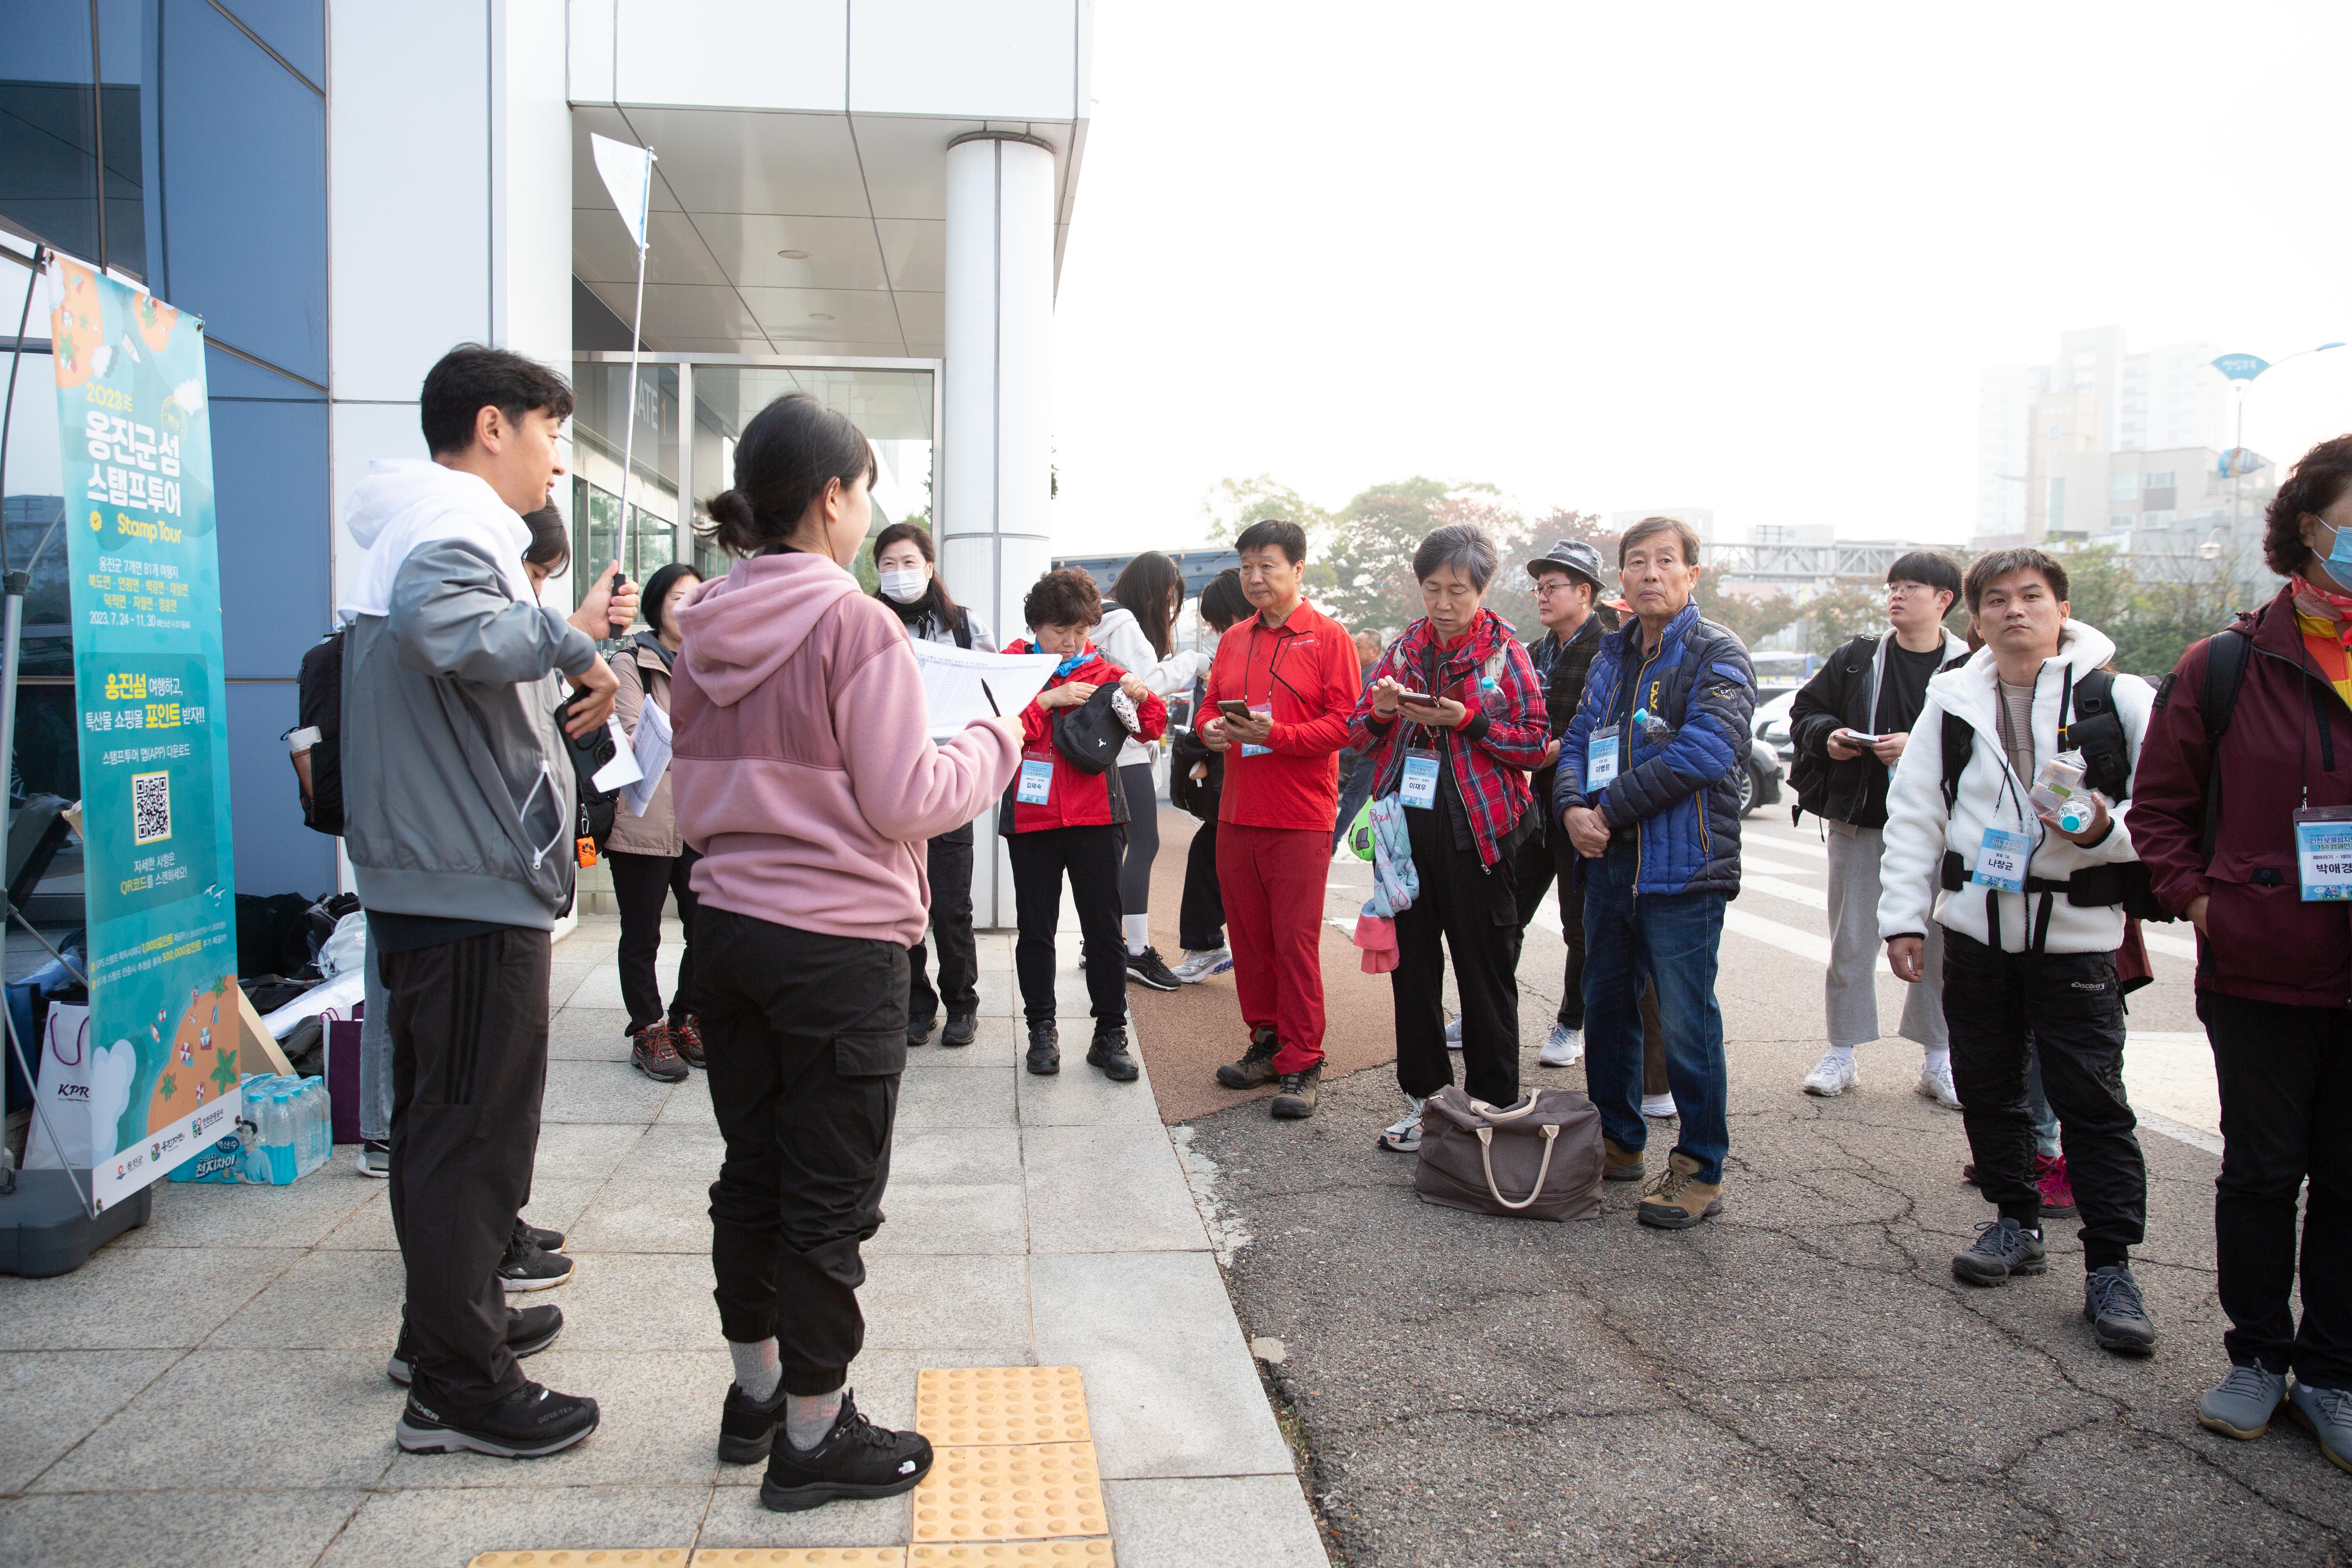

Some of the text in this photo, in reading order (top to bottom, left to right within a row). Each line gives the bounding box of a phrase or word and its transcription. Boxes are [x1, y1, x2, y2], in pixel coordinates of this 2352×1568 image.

[86, 382, 122, 411] 2023
[635, 378, 658, 430] ATE
[85, 410, 180, 477] 옹진군 섬
[87, 463, 181, 517] 스탬프투어
[118, 512, 182, 544] Stamp Tour
[99, 556, 178, 579] 옹진군 7개면 81개 여행지
[89, 574, 111, 590] 북도면
[104, 594, 127, 609] 덕적면
[105, 673, 183, 700] 옹진섬 여행하고,
[1650, 681, 1660, 710] DLX
[85, 703, 205, 731] 특산물 쇼핑몰 포인트 받자!!
[103, 743, 191, 765] 스탬프투어 앱(APP) 다운로드
[1595, 764, 1610, 773] 이병용
[1409, 782, 1426, 791] 이재우
[134, 852, 175, 873] 자세한 사항은
[1988, 859, 2013, 871] 나창균
[2316, 862, 2352, 874] 박애경
[120, 866, 188, 895] QR코드를 스캔하세요!
[96, 958, 105, 969] GPS
[106, 953, 118, 965] 스탬프
[141, 933, 174, 954] 1,000포인트
[107, 970, 121, 982] 스탬프
[122, 964, 137, 977] 인증시
[137, 959, 152, 971] 추첨을
[153, 955, 162, 967] 통해
[203, 938, 212, 947] 추가
[58, 1084, 89, 1098] KPR
[203, 1108, 224, 1126] 인천관광공사
[162, 1132, 183, 1152] 옹진자연
[217, 1140, 238, 1149] 백산수
[127, 1155, 143, 1170] 옹진군
[196, 1154, 236, 1177] 천지차이
[198, 1153, 220, 1163] 수원지가
[410, 1395, 440, 1422] EIDER
[538, 1405, 575, 1425] GORE-TEX
